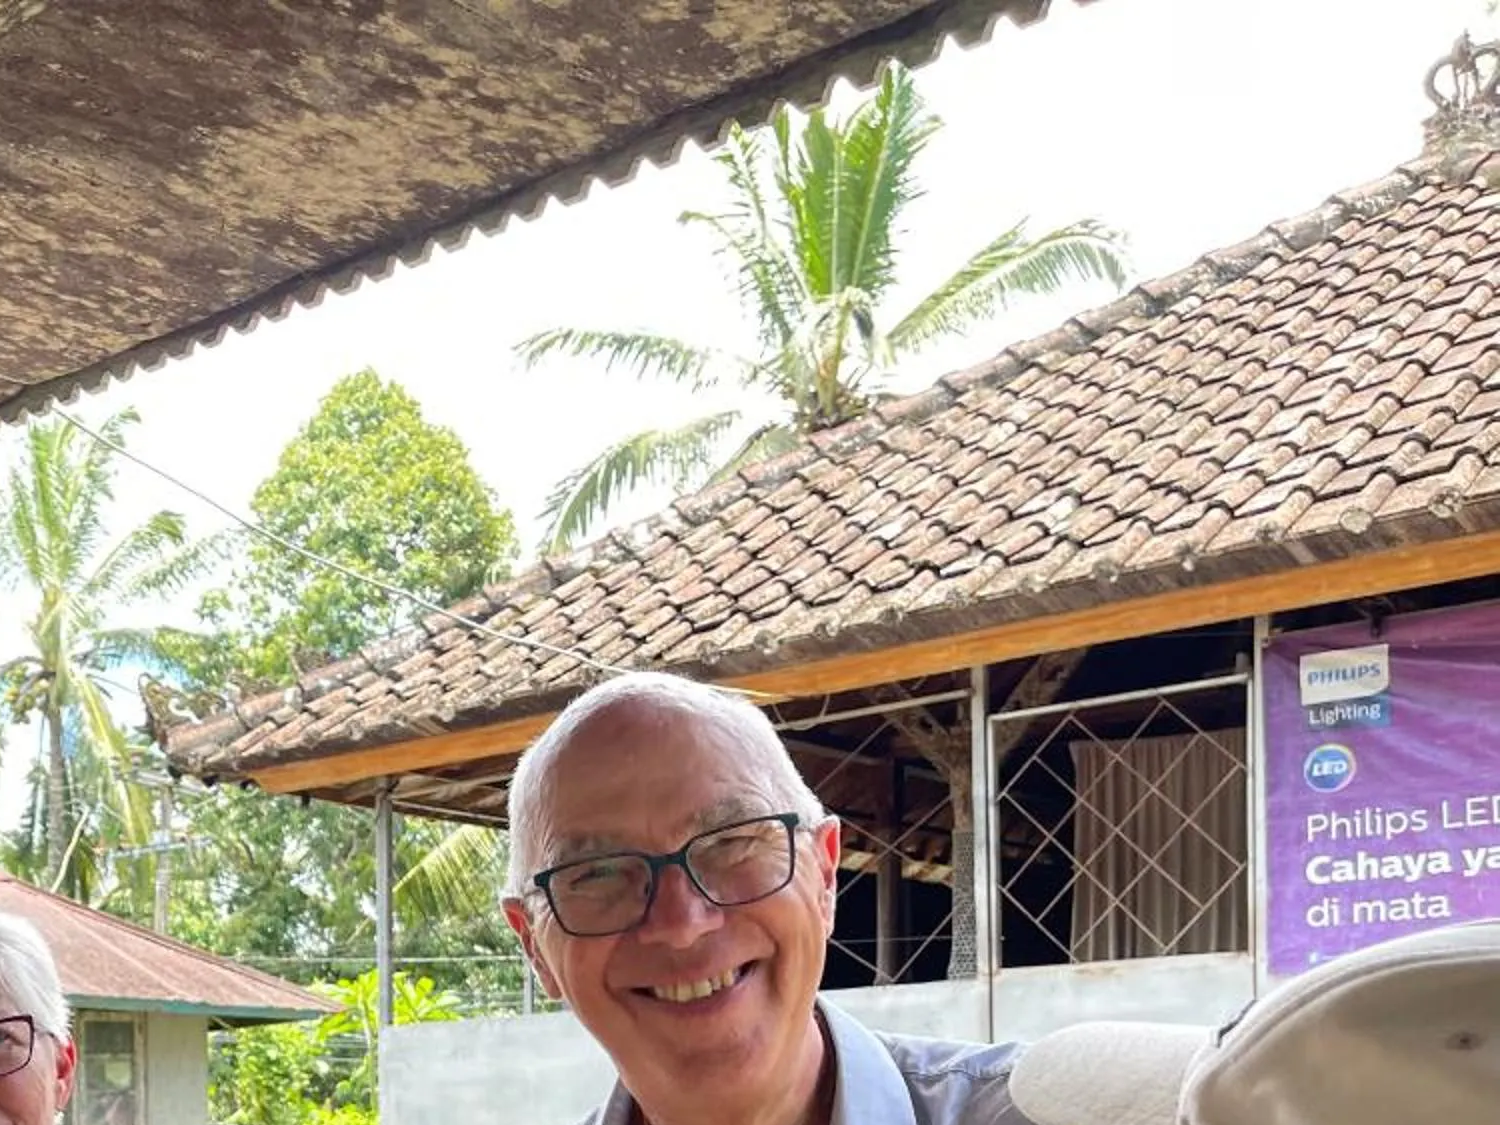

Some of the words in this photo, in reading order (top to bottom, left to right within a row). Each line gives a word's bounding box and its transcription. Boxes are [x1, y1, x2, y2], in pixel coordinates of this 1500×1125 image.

[1307, 662, 1381, 685] PHILIPS
[1308, 703, 1381, 726] Lighting
[1312, 759, 1348, 777] LED
[1307, 808, 1429, 843] Philips
[1306, 850, 1452, 885] Cahaya
[1306, 898, 1339, 928] di
[1353, 894, 1451, 924] mata
